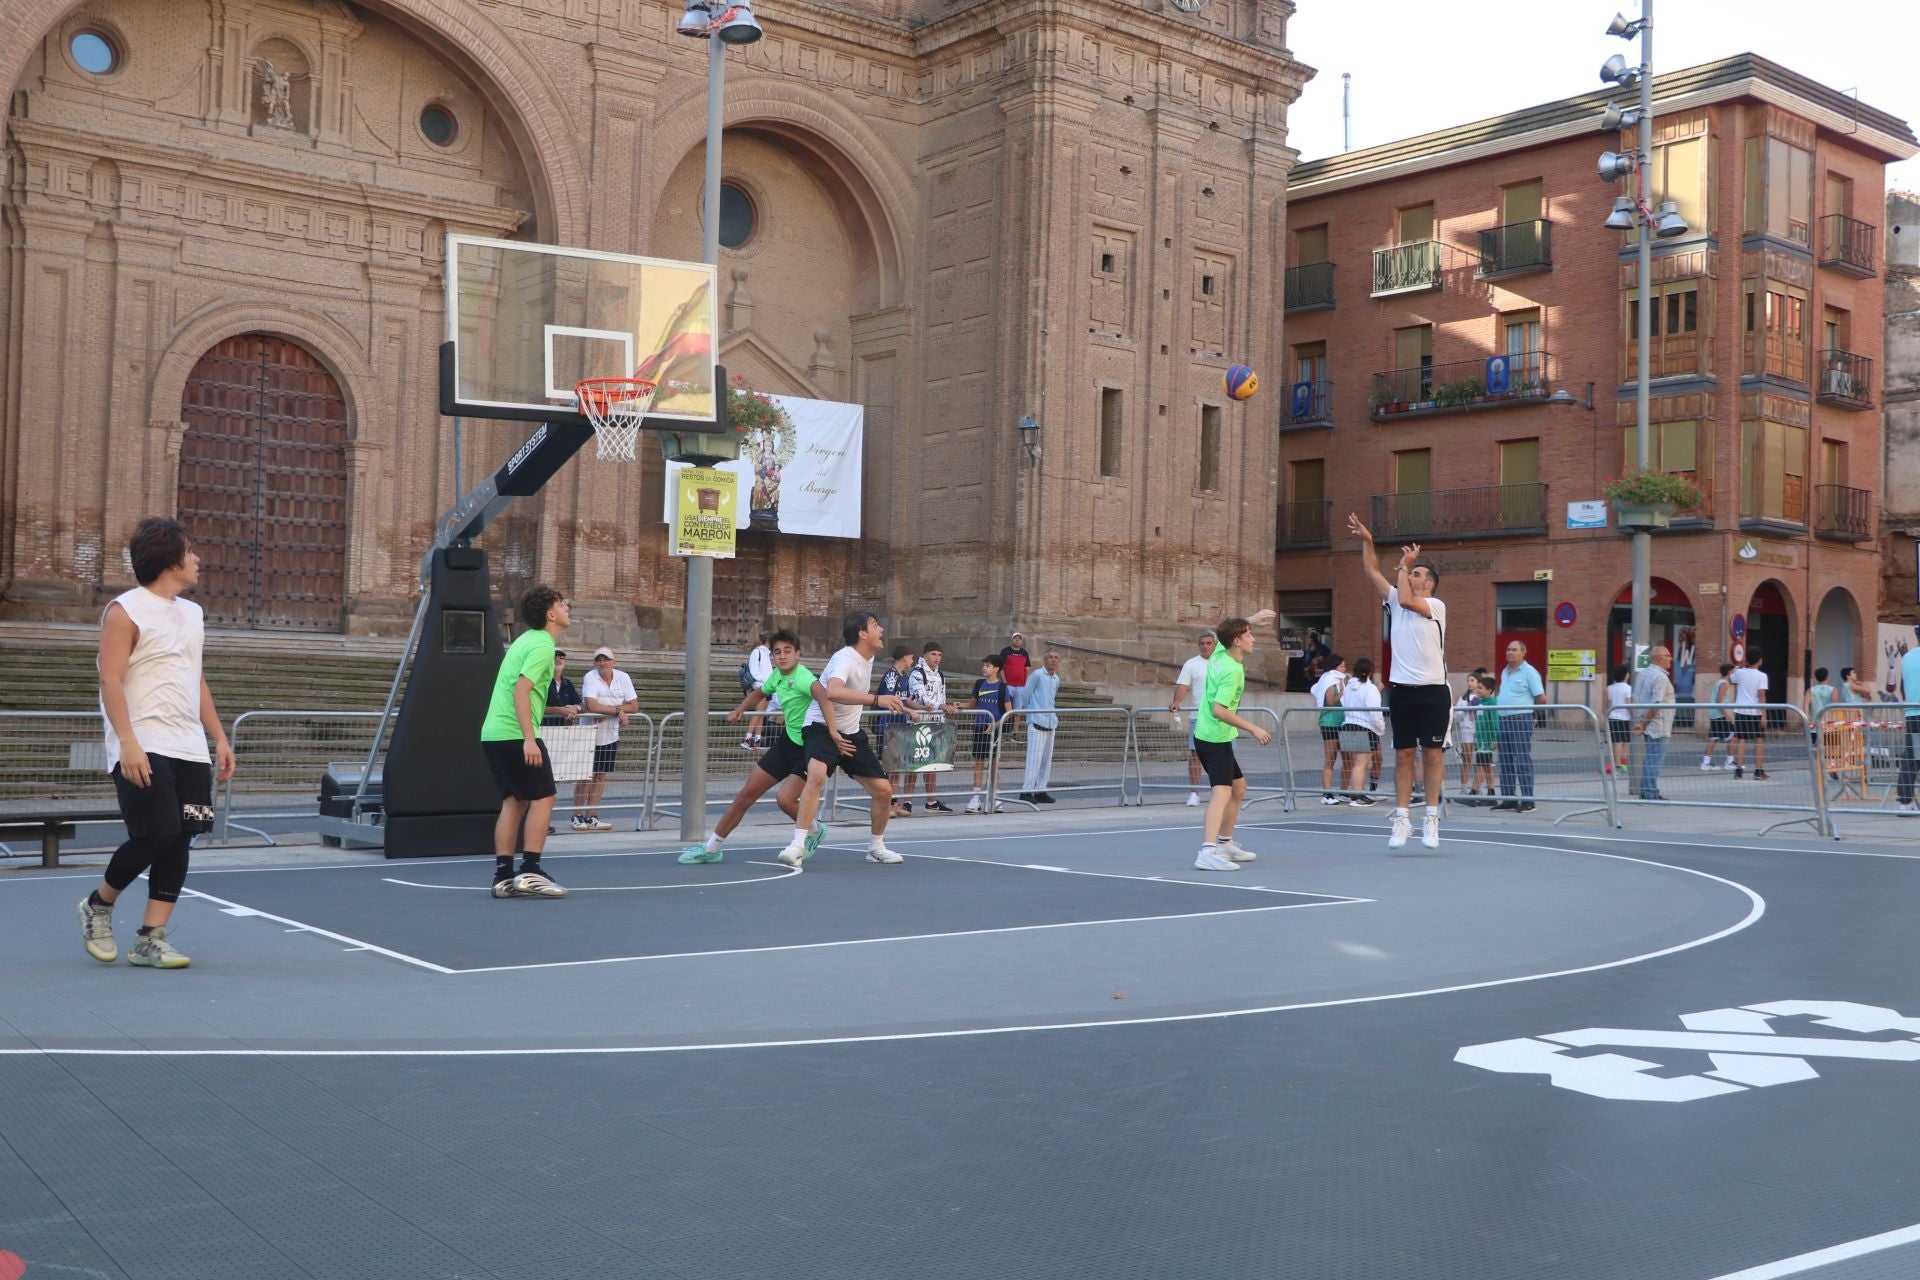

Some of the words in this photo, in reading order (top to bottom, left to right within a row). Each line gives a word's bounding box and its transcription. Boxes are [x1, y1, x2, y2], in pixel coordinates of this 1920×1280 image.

[804, 442, 847, 464] Virgen
[681, 473, 705, 481] RESTOS
[713, 476, 735, 484] COMIDA
[683, 521, 731, 530] CONTENEDOR
[683, 528, 731, 540] MARRÓN
